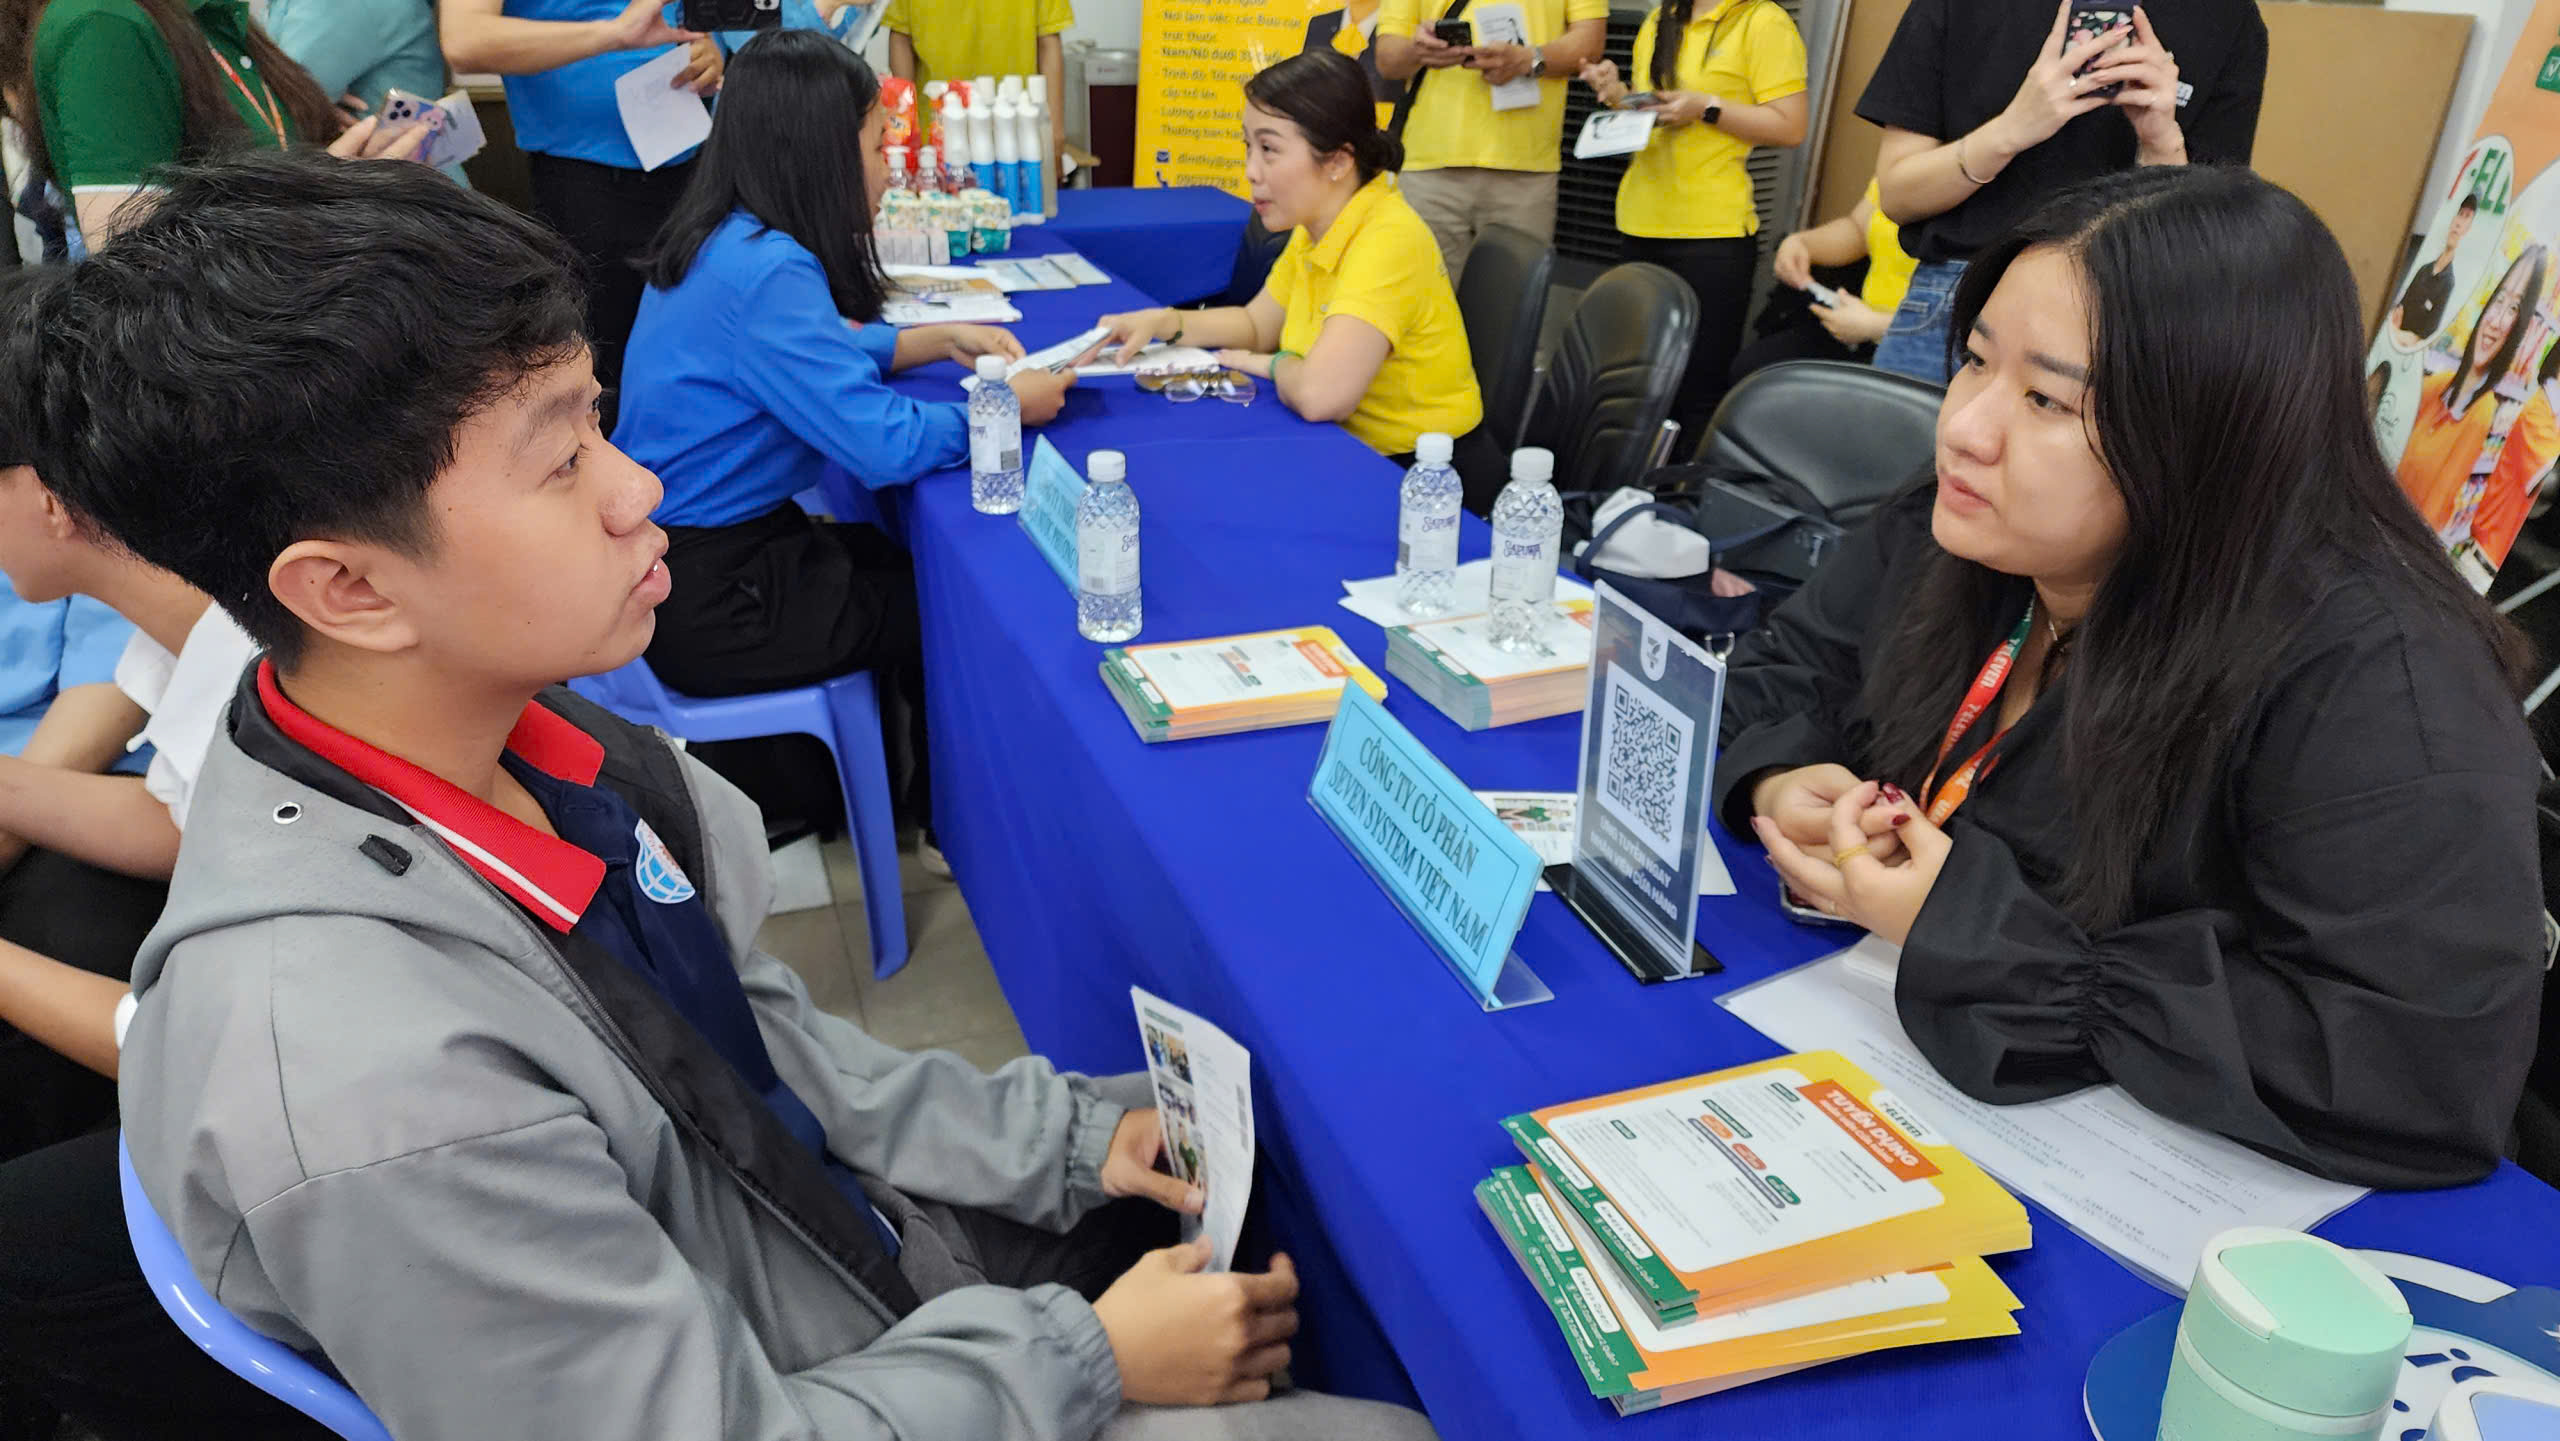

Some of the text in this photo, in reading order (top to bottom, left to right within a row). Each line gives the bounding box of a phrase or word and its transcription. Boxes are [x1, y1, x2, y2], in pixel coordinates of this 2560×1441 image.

[1360, 737, 1398, 793] CÔNG
[1395, 771, 1417, 812] TY
[1328, 760, 1489, 957] SEVEN SYSTEM VIỆT NAM
[1870, 1127, 1920, 1167] DỤNG
